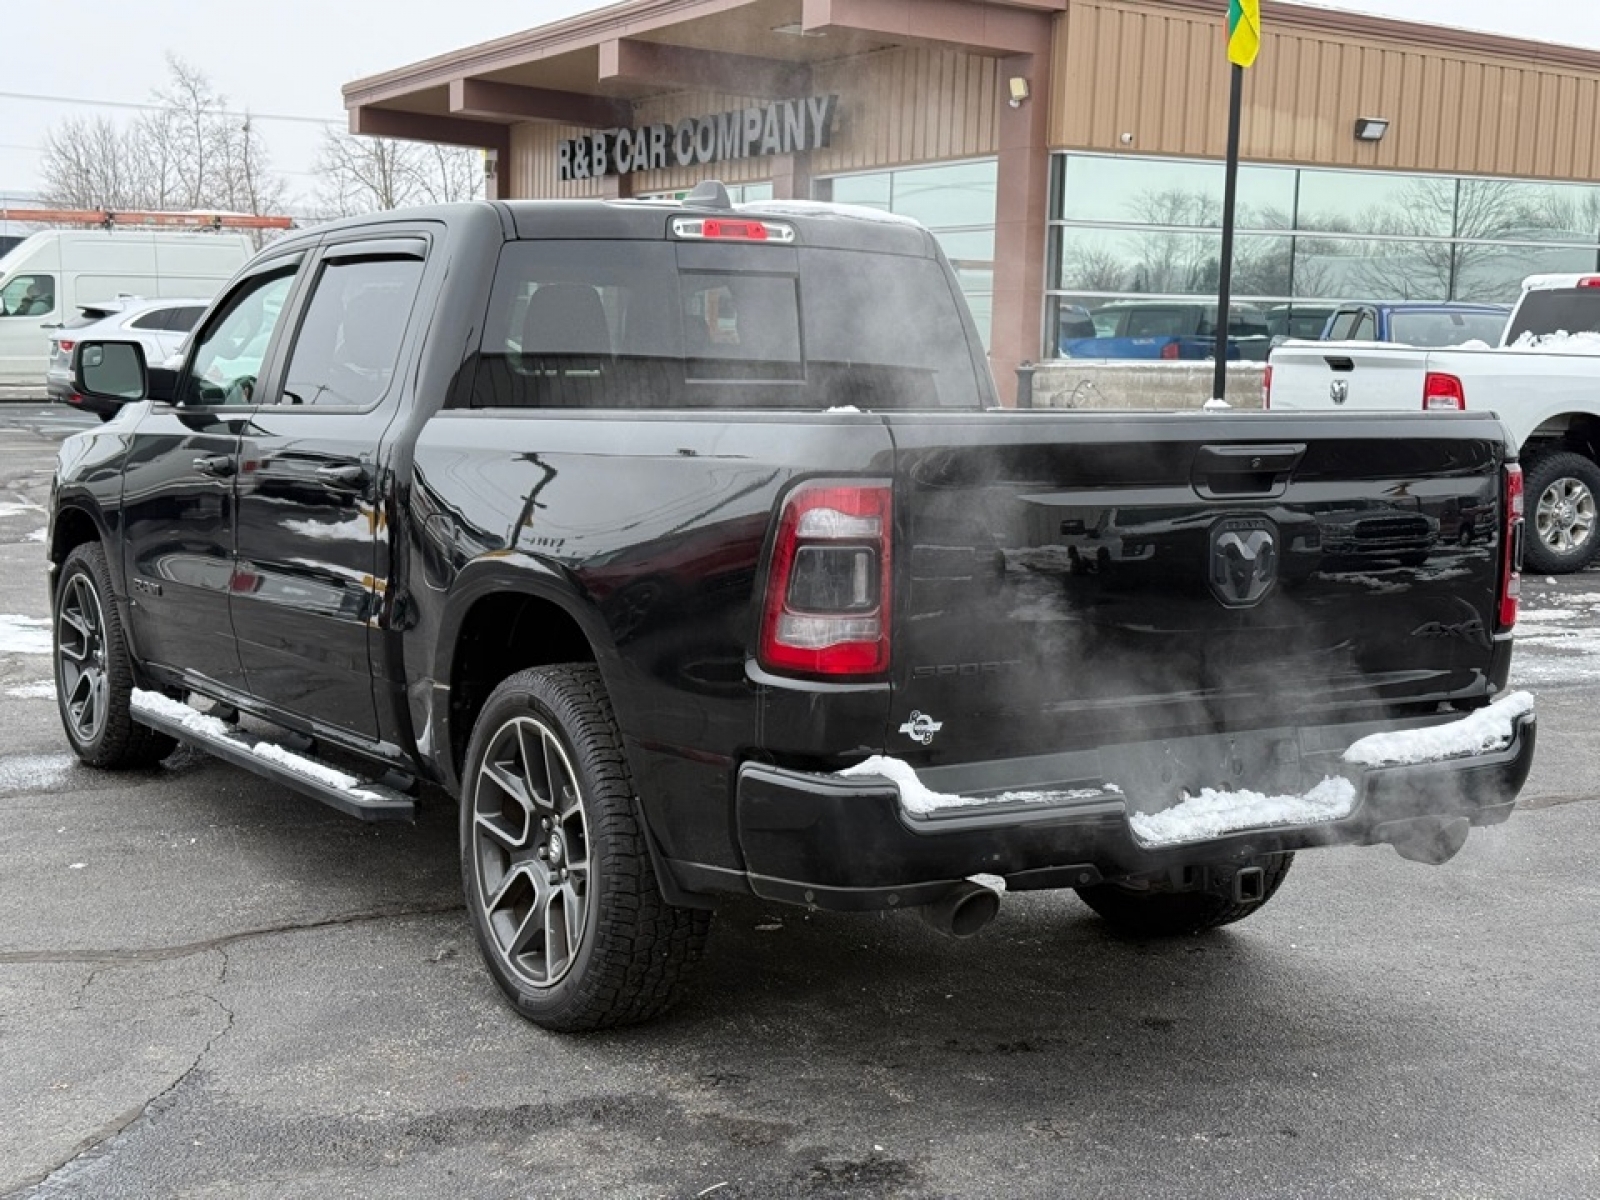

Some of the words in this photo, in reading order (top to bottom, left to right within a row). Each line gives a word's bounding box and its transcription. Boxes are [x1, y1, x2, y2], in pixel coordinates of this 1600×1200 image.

[559, 139, 608, 181] R&B
[614, 125, 668, 175] CAR
[673, 95, 835, 166] COMPANY
[914, 659, 1023, 677] SPORT
